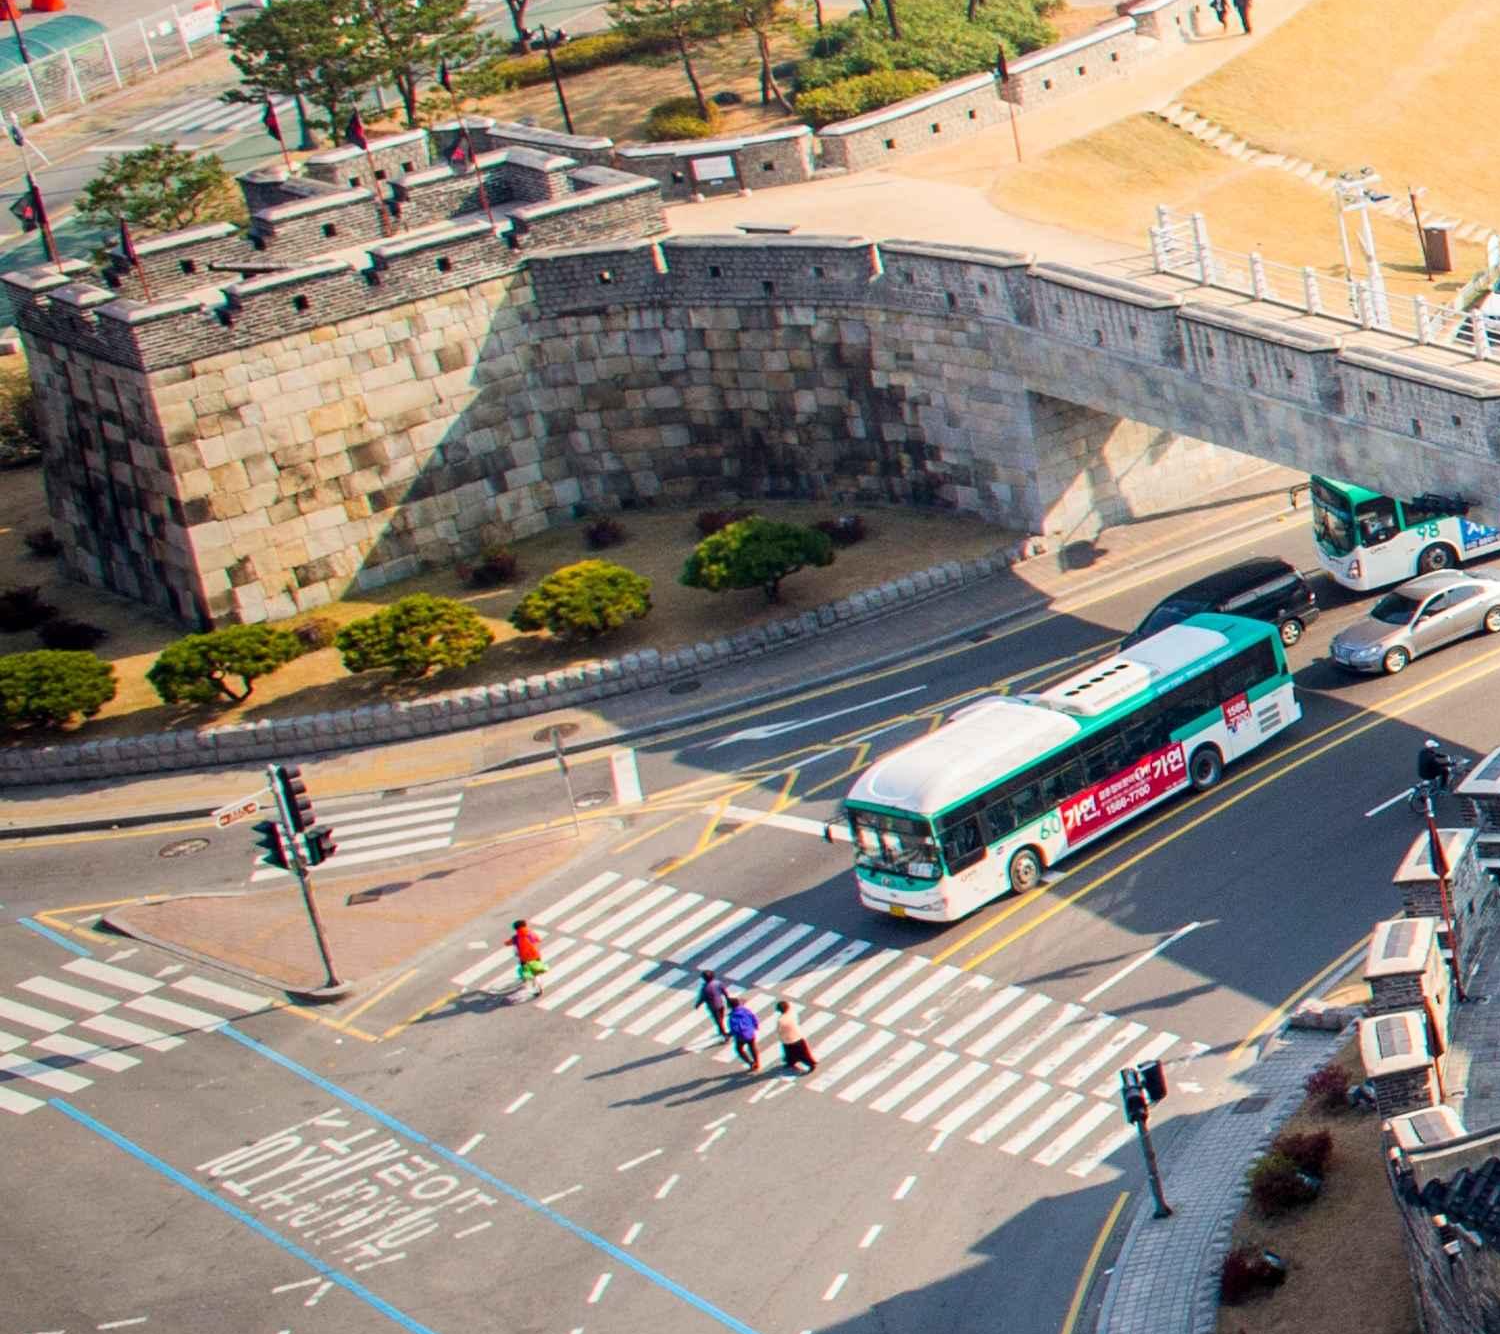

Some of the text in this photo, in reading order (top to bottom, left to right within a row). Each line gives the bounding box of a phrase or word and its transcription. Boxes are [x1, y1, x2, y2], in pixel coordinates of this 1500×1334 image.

[1417, 524, 1440, 541] 98
[1152, 746, 1184, 779] 가연
[1039, 814, 1061, 841] 60
[1064, 794, 1101, 831] 가연,
